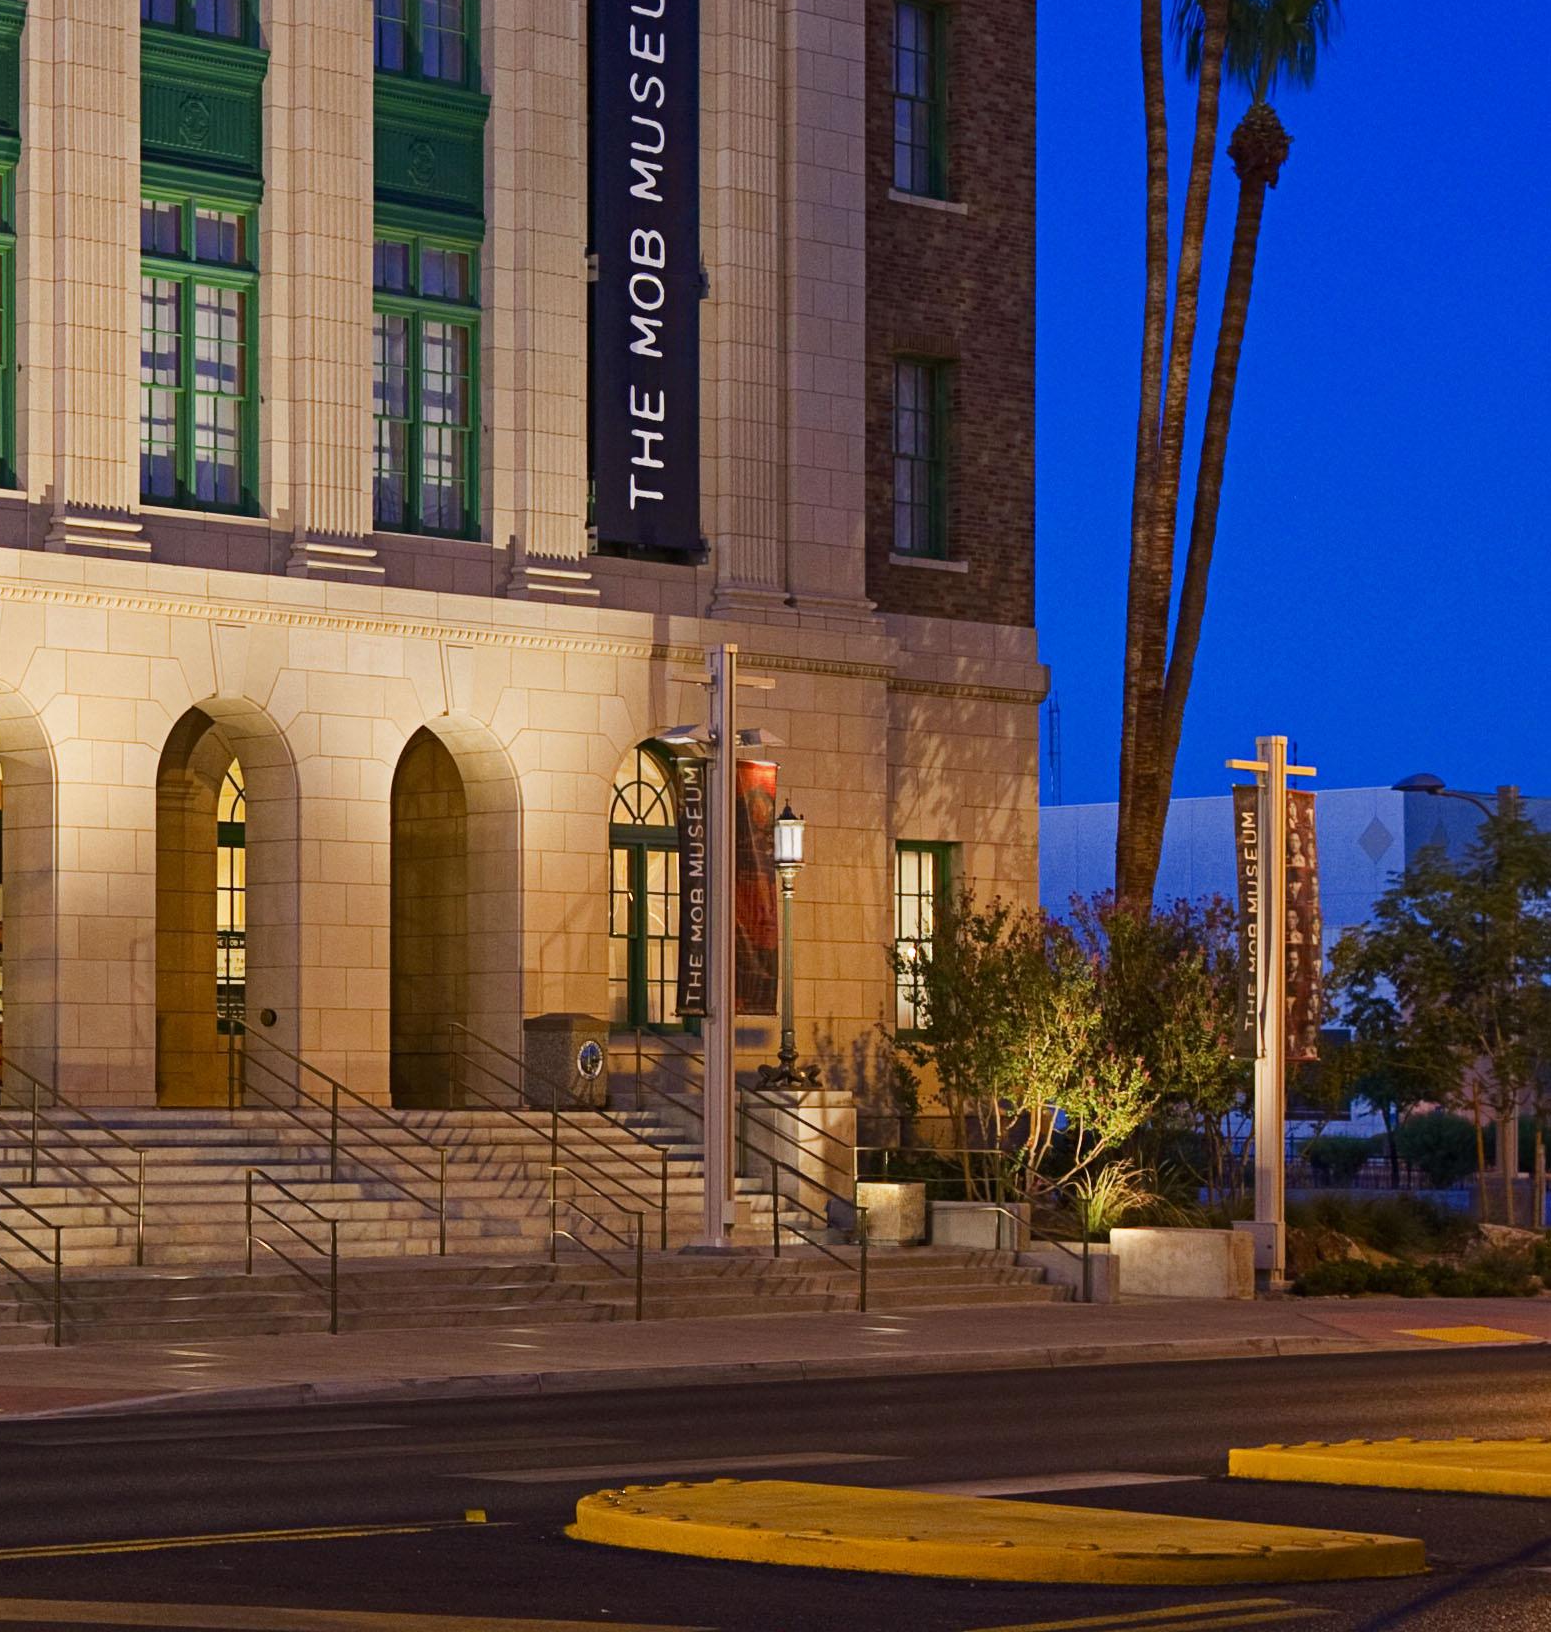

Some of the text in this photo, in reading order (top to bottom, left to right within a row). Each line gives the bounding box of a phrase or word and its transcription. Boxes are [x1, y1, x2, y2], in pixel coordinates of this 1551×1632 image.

[629, 228, 666, 358] MOB
[629, 384, 665, 511] THE
[683, 766, 705, 1004] THE MOB MUSEUM
[1241, 812, 1258, 914] MUSEUM
[1244, 983, 1257, 1031] THE
